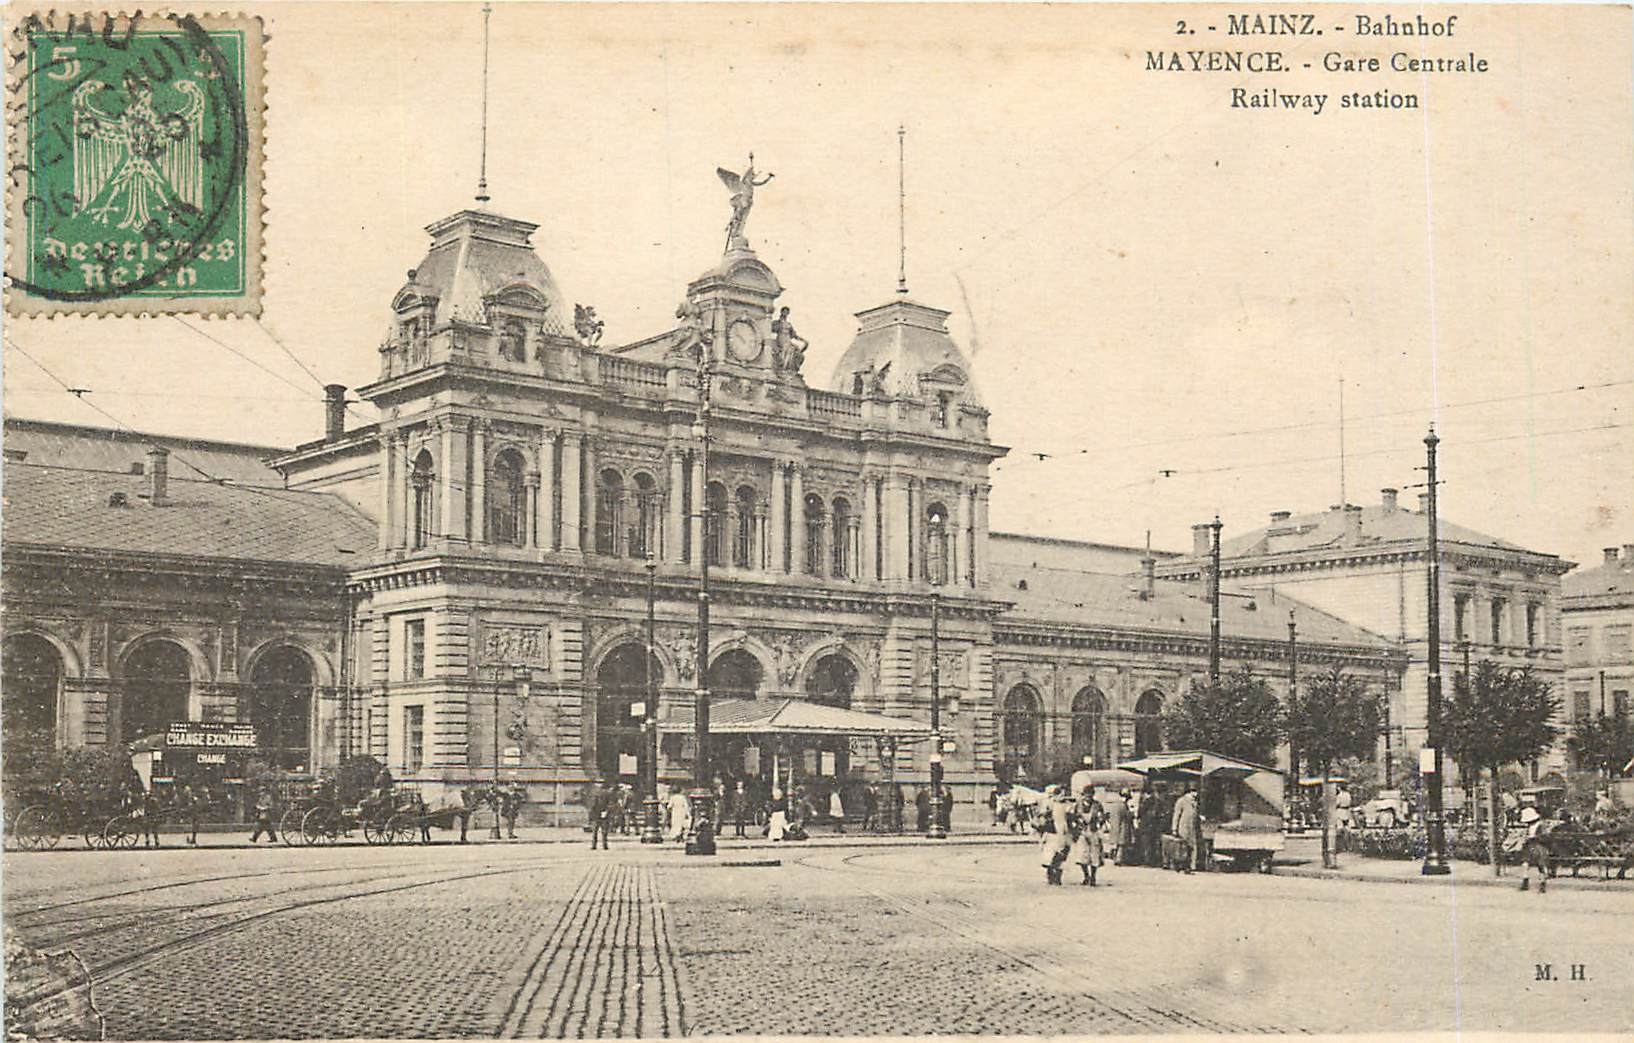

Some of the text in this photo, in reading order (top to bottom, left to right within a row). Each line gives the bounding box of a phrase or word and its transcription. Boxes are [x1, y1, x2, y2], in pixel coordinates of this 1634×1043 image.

[47, 46, 81, 80] 5
[166, 733, 257, 747] CHANGE EXCHANGE
